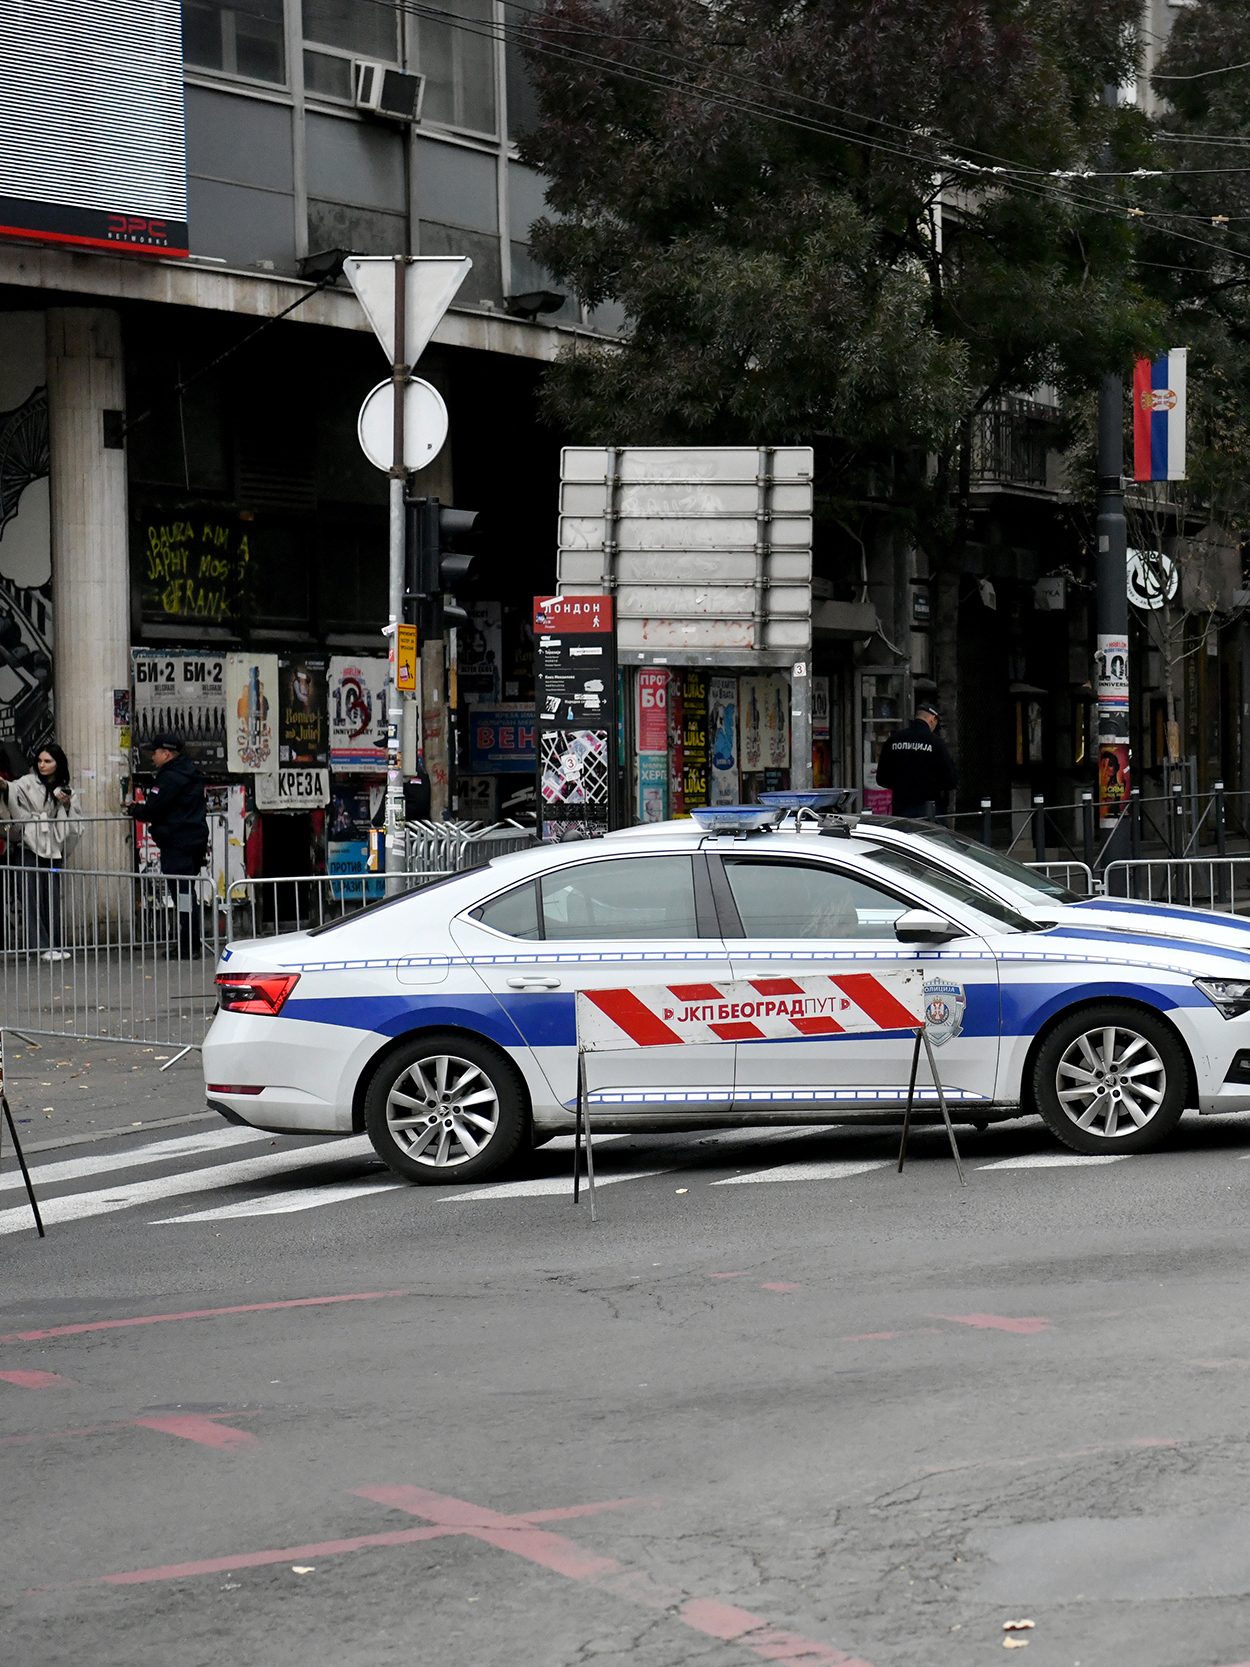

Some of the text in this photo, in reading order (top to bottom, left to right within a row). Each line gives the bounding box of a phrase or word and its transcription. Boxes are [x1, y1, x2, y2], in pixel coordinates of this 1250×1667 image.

[544, 603, 601, 614] ЛОНДОН
[285, 708, 316, 724] Romeo
[892, 742, 933, 752] ПОЛИЦИЈА
[279, 773, 323, 796] КРЕЗА
[330, 862, 362, 874] ПРОТИВ
[677, 1006, 714, 1022] ЈКП
